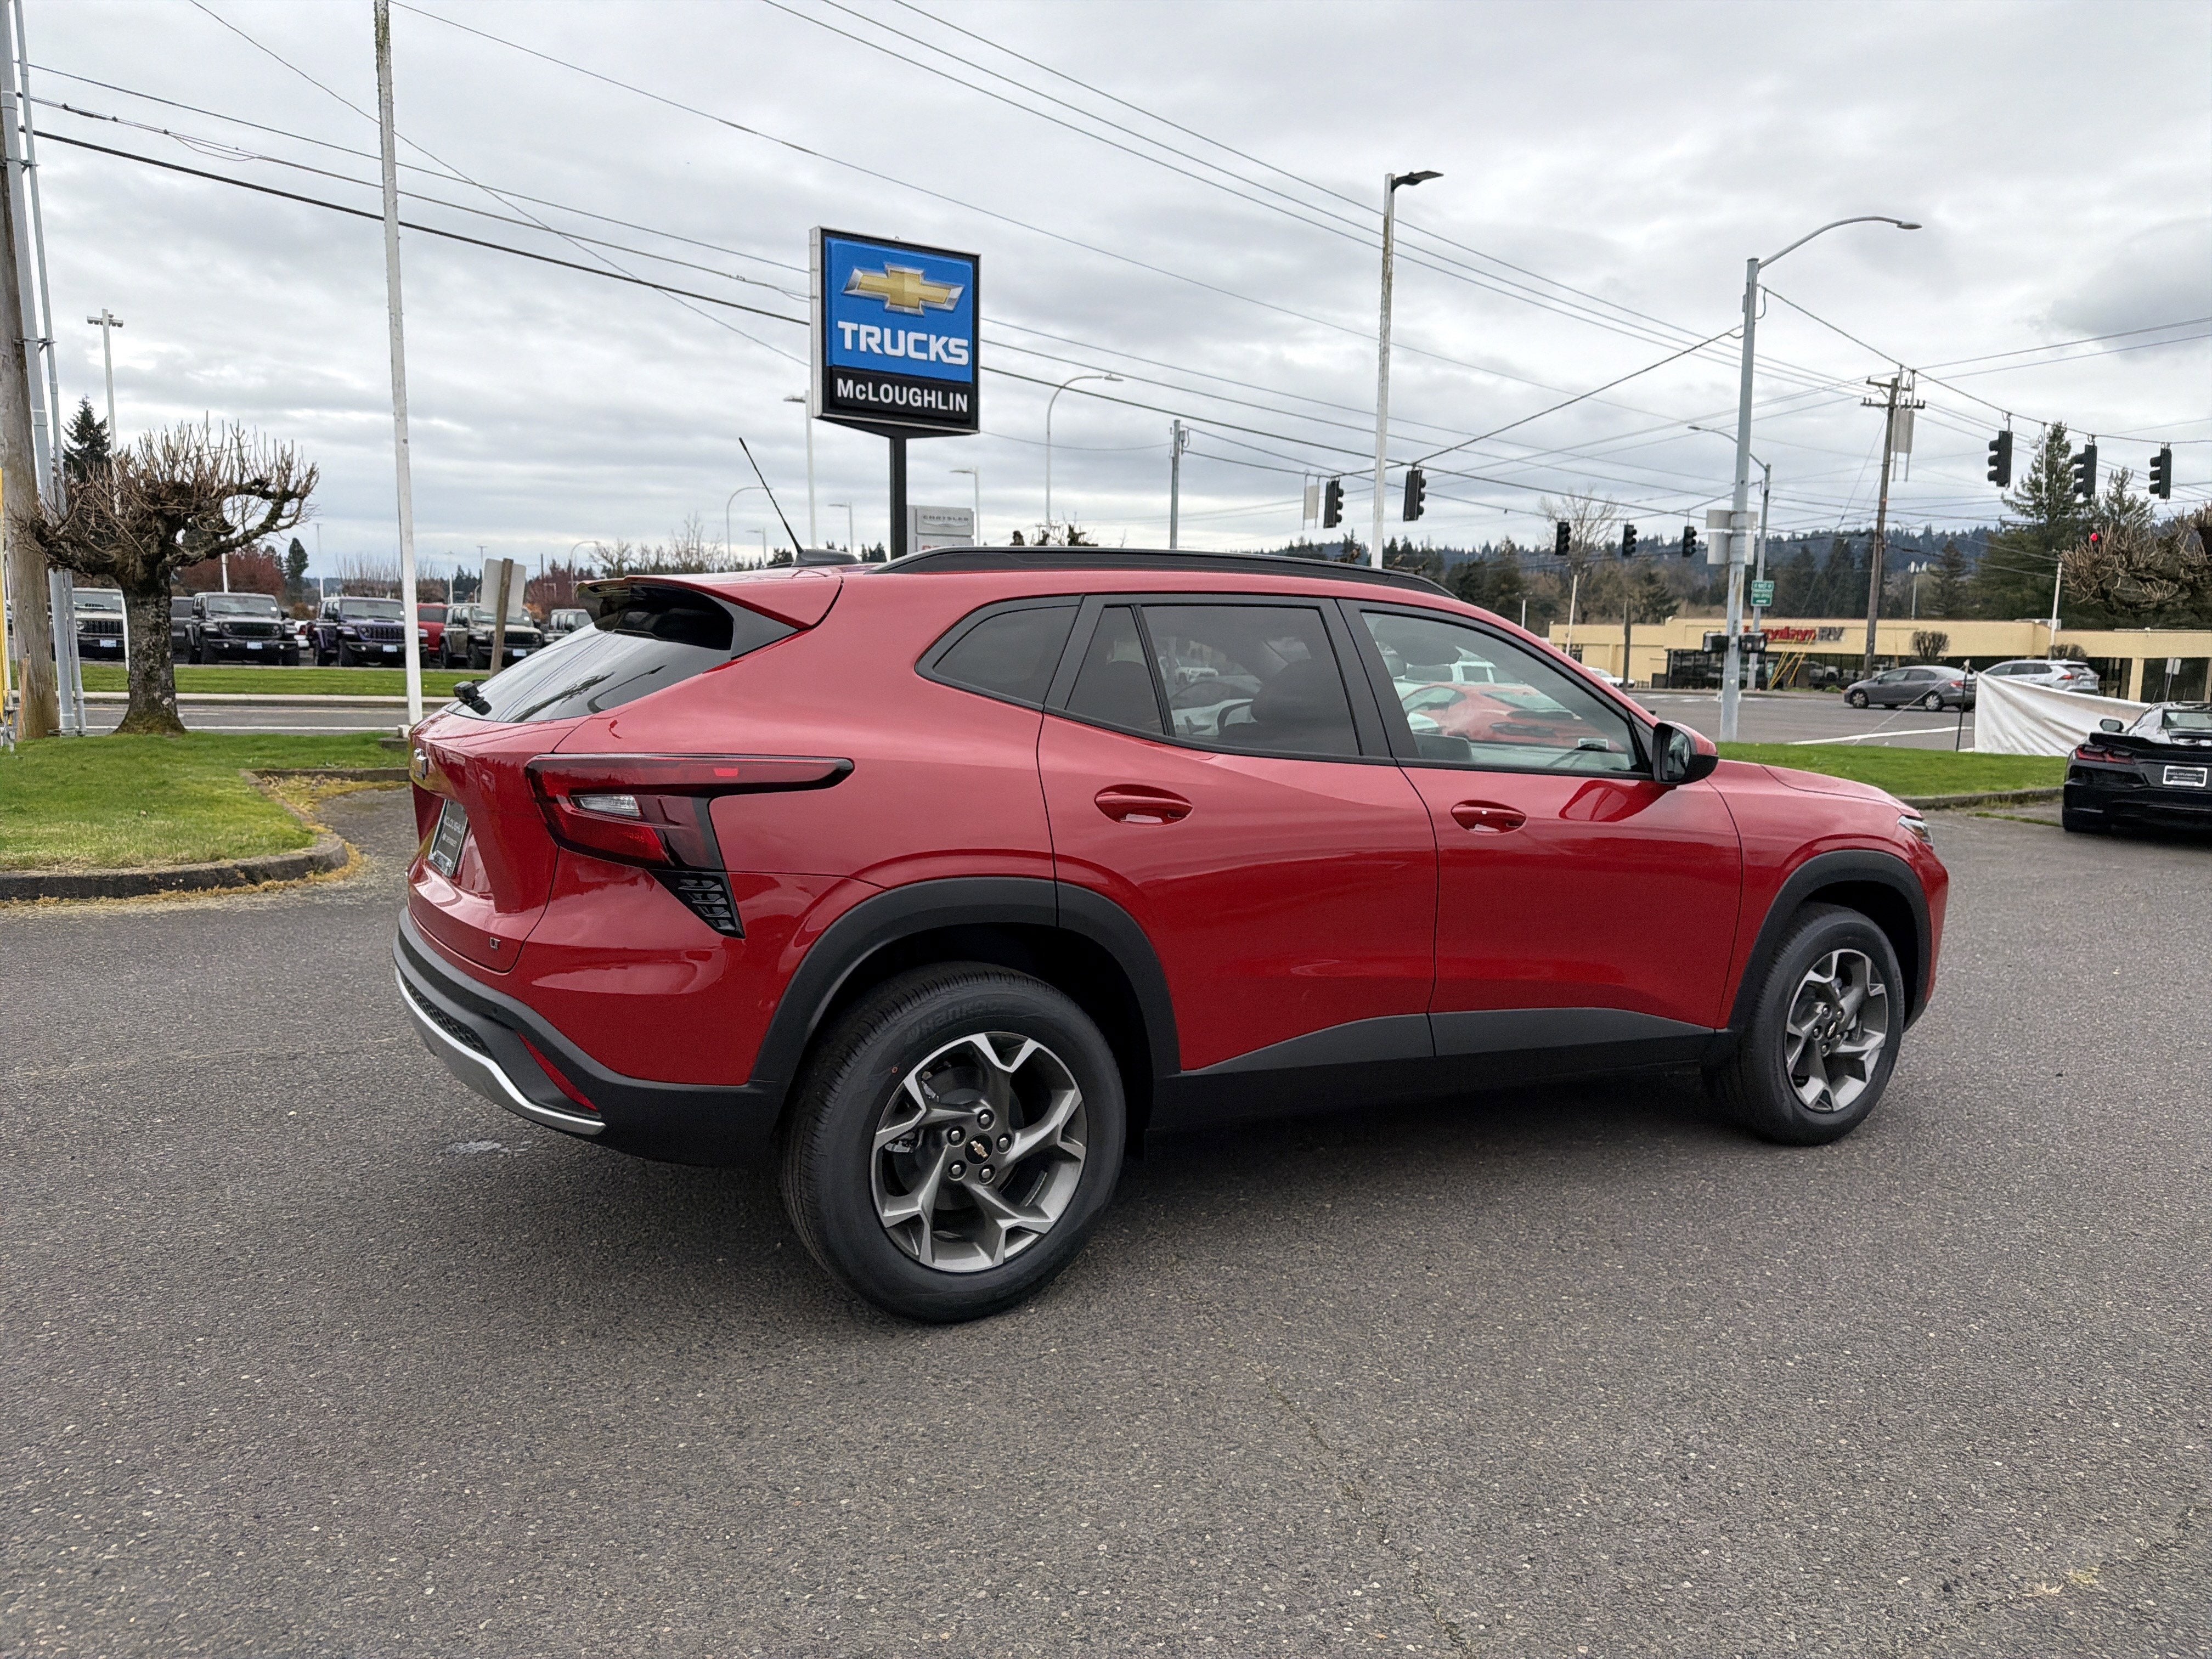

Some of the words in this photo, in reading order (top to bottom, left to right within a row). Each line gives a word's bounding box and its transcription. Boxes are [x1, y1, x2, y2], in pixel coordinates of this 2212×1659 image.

[837, 320, 969, 366] TRUCKS
[837, 378, 968, 413] McLOUGHLIN
[1818, 626, 1844, 642] RV
